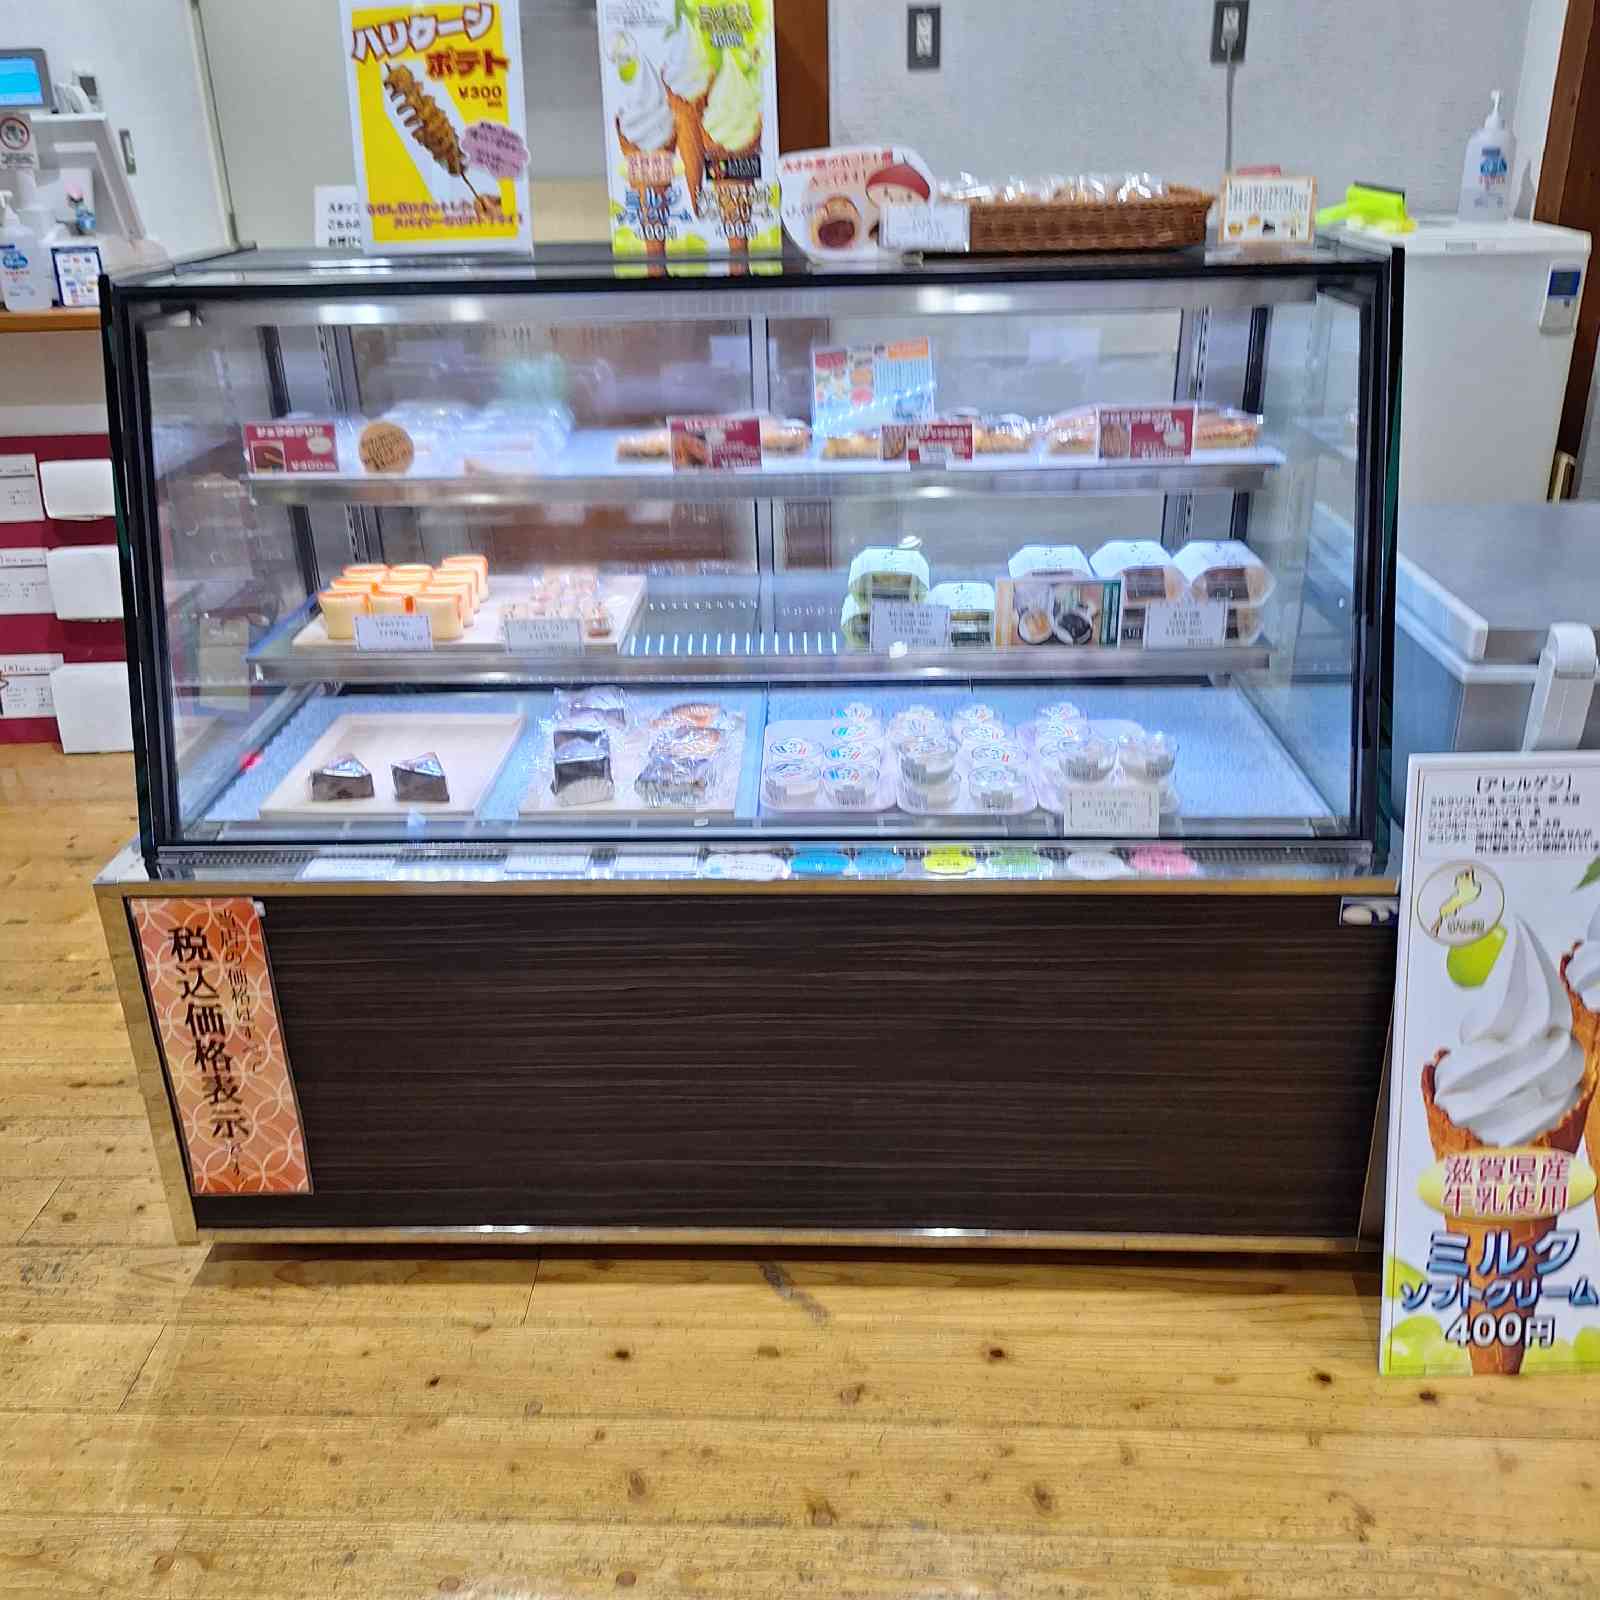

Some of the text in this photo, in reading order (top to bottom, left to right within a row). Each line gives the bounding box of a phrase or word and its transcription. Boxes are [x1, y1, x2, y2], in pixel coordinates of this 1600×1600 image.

[351, 2, 494, 62] ハリケーン
[427, 46, 509, 79] ポテト
[167, 927, 249, 1138] 税込価格表示
[1444, 1154, 1570, 1186] 滋賀県産
[1442, 1184, 1568, 1216] 牛乳使用
[1427, 1229, 1580, 1278] ミルク
[1401, 1275, 1599, 1312] ソフトクリーム
[1445, 1312, 1556, 1348] 400円
